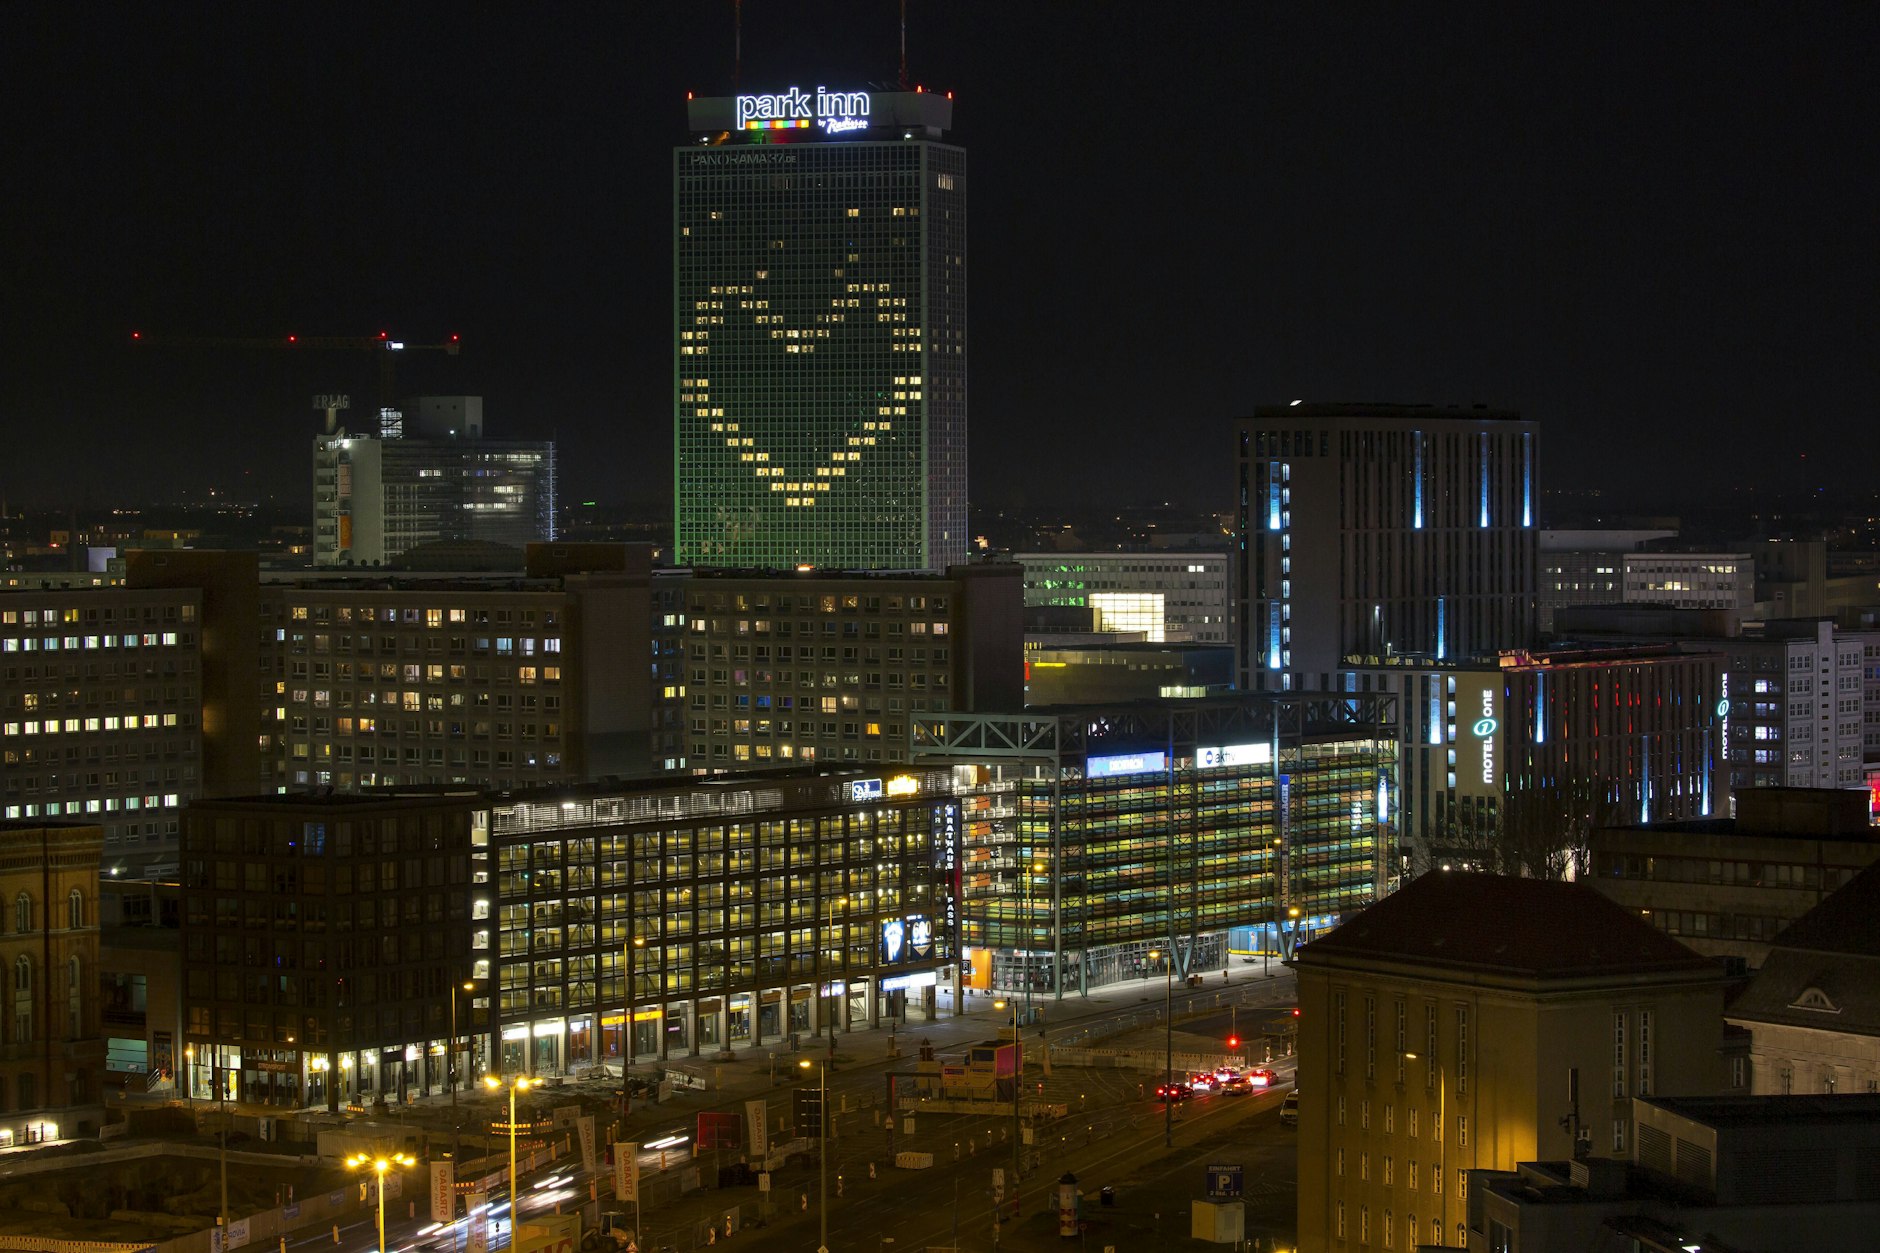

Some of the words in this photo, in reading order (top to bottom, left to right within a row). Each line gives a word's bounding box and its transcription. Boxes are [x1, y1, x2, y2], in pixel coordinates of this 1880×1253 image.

[737, 87, 812, 130] park
[817, 86, 870, 116] inn
[1483, 689, 1493, 717] ONE
[1483, 736, 1493, 783] MOTEL
[946, 817, 954, 870] RATHAUS
[1218, 1175, 1231, 1189] P
